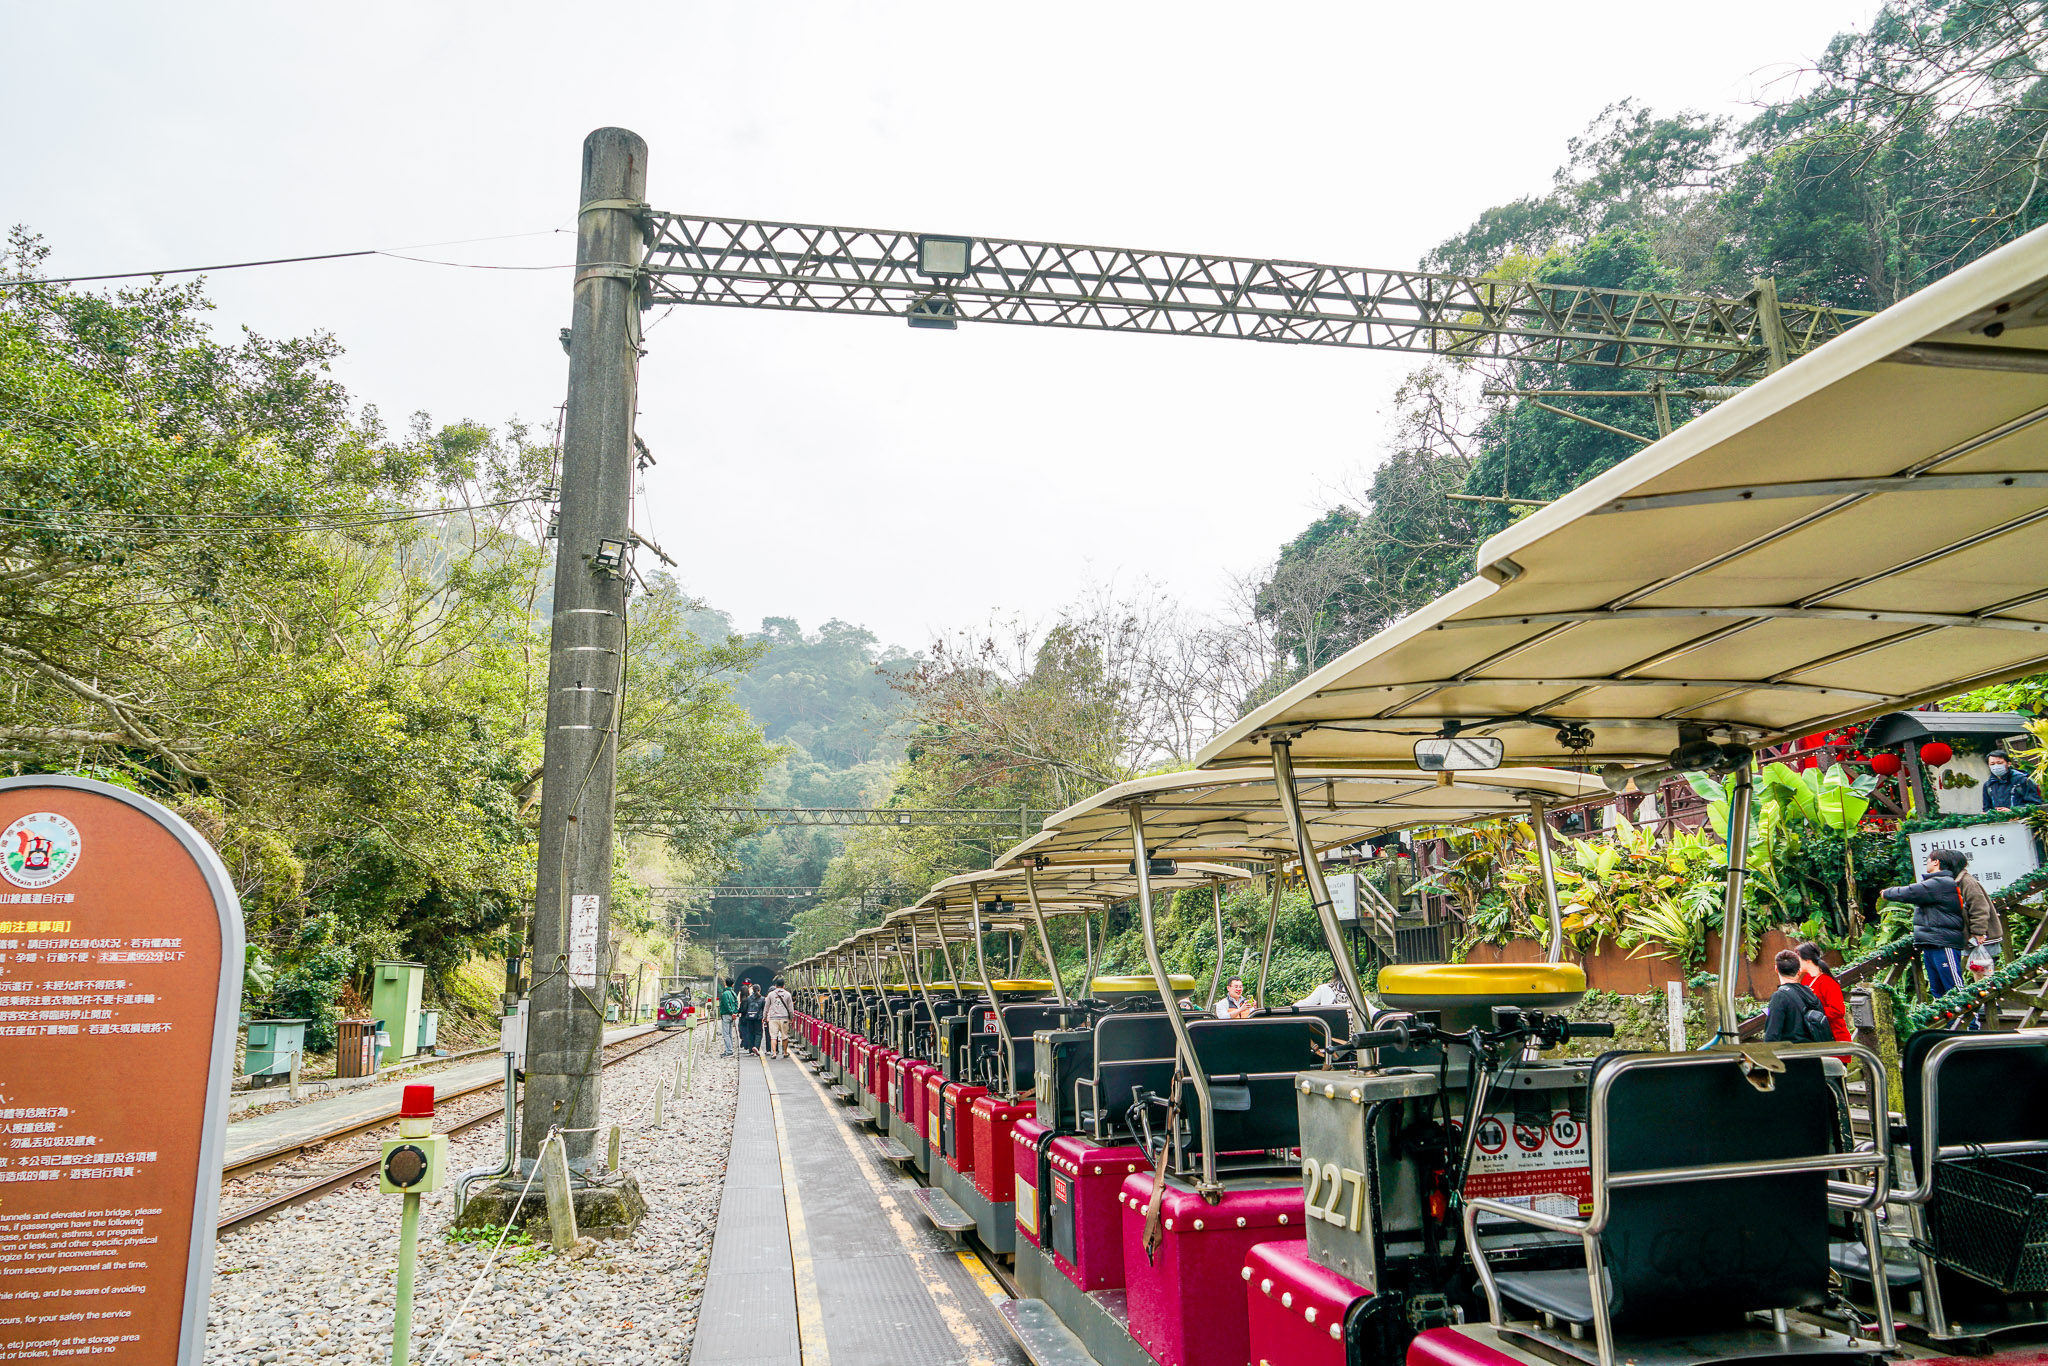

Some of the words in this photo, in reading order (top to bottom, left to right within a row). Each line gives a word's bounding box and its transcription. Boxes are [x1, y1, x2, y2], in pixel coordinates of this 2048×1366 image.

[1920, 843, 1928, 853] 3
[1971, 834, 2006, 848] Café
[34, 879, 51, 887] Line
[1555, 1122, 1574, 1139] 10
[1303, 1157, 1365, 1233] 227
[1, 1213, 31, 1221] tunnels
[32, 1212, 49, 1220] and
[50, 1210, 86, 1219] elevated
[87, 1209, 104, 1217] iron
[105, 1208, 133, 1218] bridge,
[134, 1207, 162, 1217] please
[13, 1222, 20, 1231] if
[20, 1221, 69, 1231] passengers
[70, 1220, 91, 1228] have
[92, 1219, 107, 1227] the
[108, 1218, 144, 1227] following
[23, 1232, 60, 1240] drunken,
[61, 1229, 95, 1238] asthma,
[107, 1227, 144, 1237] pregnant
[29, 1241, 49, 1249] less,
[50, 1240, 67, 1248] and
[68, 1239, 91, 1247] other
[91, 1237, 123, 1248] specific
[124, 1235, 158, 1247] physical
[23, 1251, 36, 1259] for
[37, 1251, 56, 1261] your
[57, 1248, 119, 1258] inconvenience.
[3, 1267, 23, 1275] from
[24, 1265, 58, 1274] security
[58, 1262, 101, 1273] personnel
[101, 1262, 112, 1270] all
[113, 1261, 127, 1269] the
[128, 1260, 148, 1269] time,
[15, 1290, 40, 1300] riding,
[42, 1289, 59, 1297] and
[60, 1288, 72, 1296] be
[73, 1287, 99, 1296] aware
[100, 1286, 111, 1294] of
[111, 1285, 146, 1294] avoiding
[24, 1314, 37, 1323] for
[38, 1314, 58, 1324] your
[58, 1312, 85, 1321] safety
[86, 1311, 99, 1319] the
[101, 1309, 132, 1318] service
[7, 1340, 24, 1349] etc)
[25, 1338, 61, 1349] properly
[62, 1337, 71, 1345] at
[72, 1336, 86, 1344] the
[87, 1336, 119, 1344] storage
[18, 1350, 50, 1359] broken,
[52, 1348, 74, 1356] there
[76, 1345, 90, 1354] will
[91, 1345, 103, 1353] be
